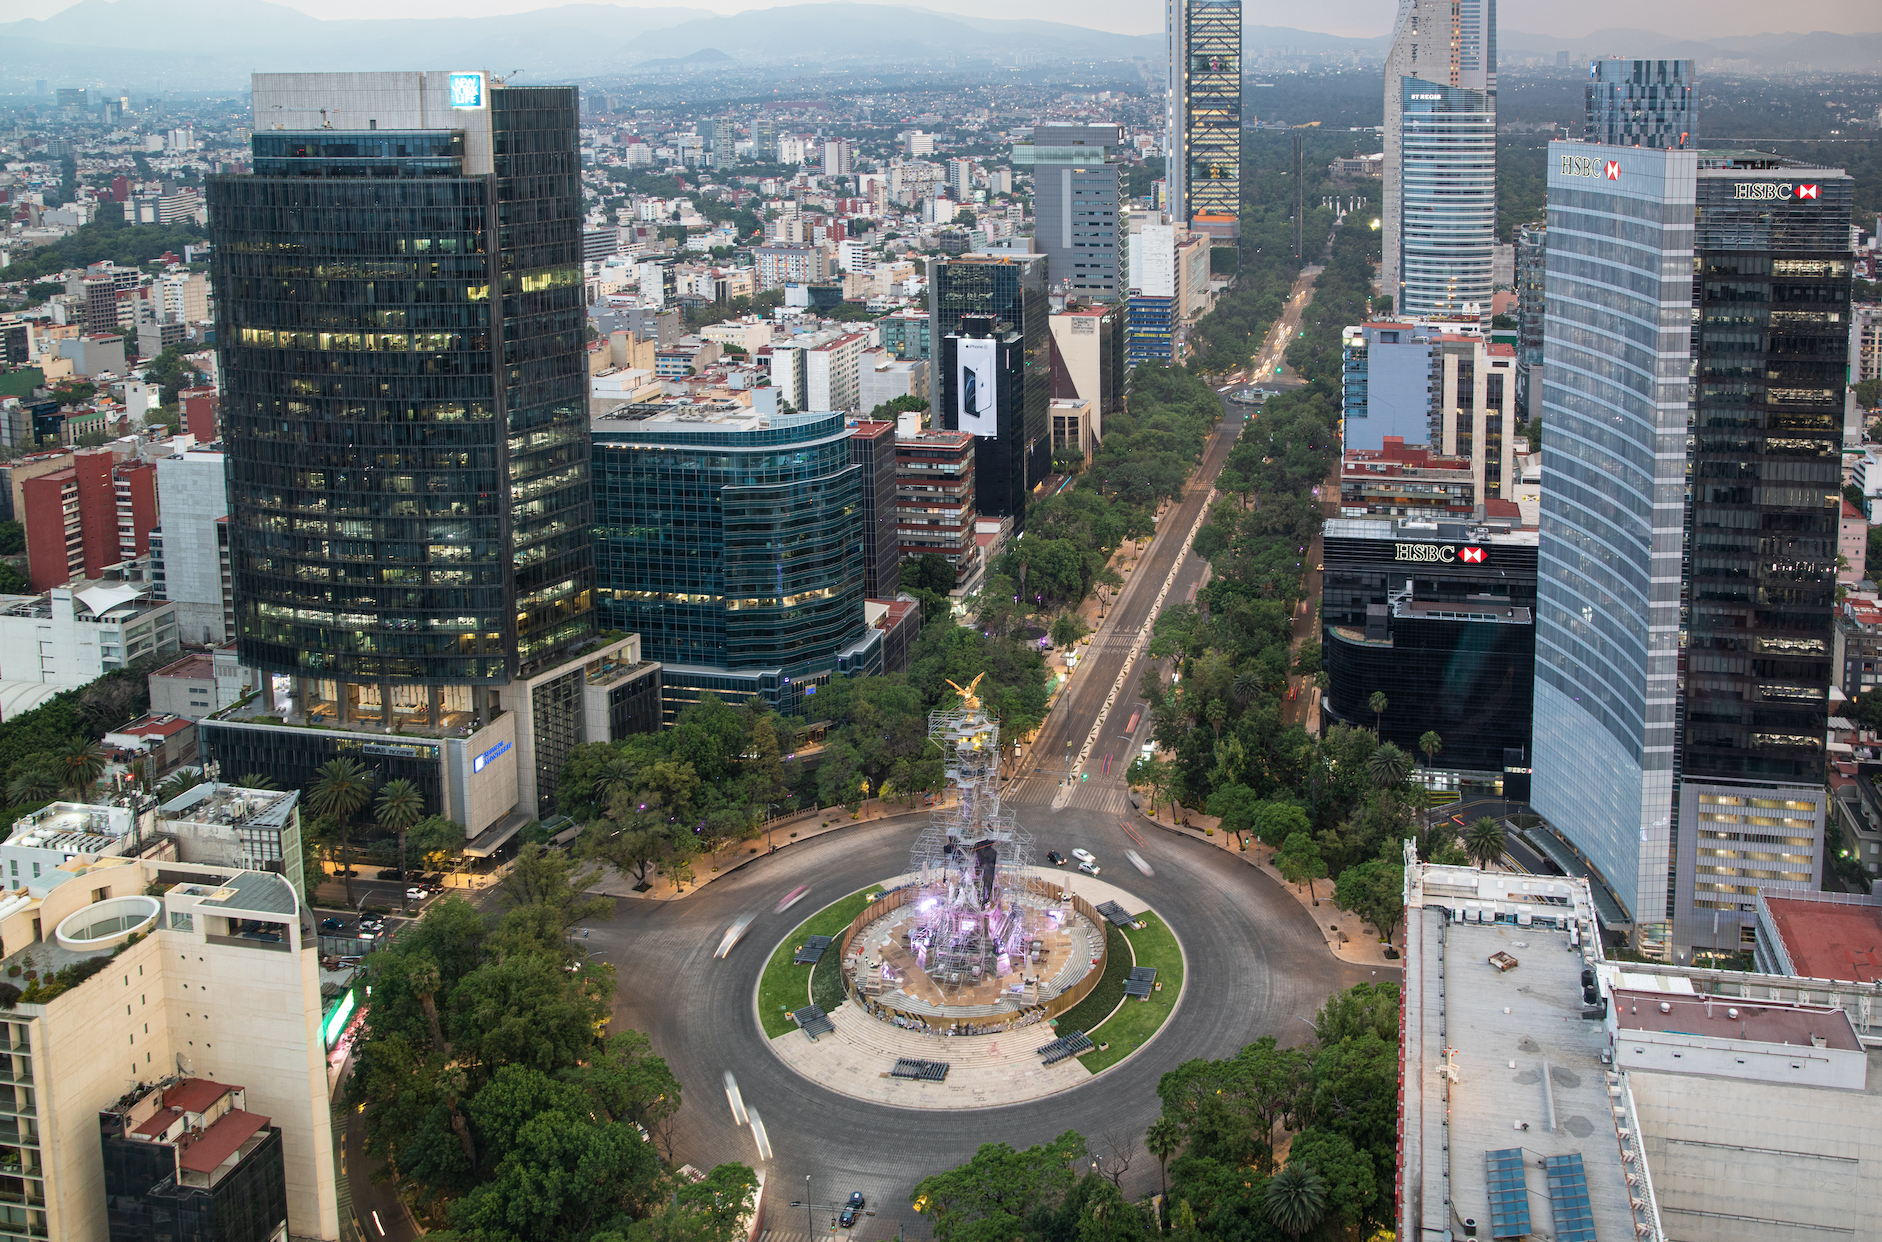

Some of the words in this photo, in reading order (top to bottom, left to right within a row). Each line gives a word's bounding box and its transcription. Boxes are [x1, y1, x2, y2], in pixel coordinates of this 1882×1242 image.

[455, 78, 476, 87] NEW
[451, 86, 478, 95] YORK
[456, 95, 476, 103] LIFE
[1561, 155, 1601, 178] HSBC
[1734, 183, 1792, 200] HSBC
[1395, 543, 1455, 563] HSBC
